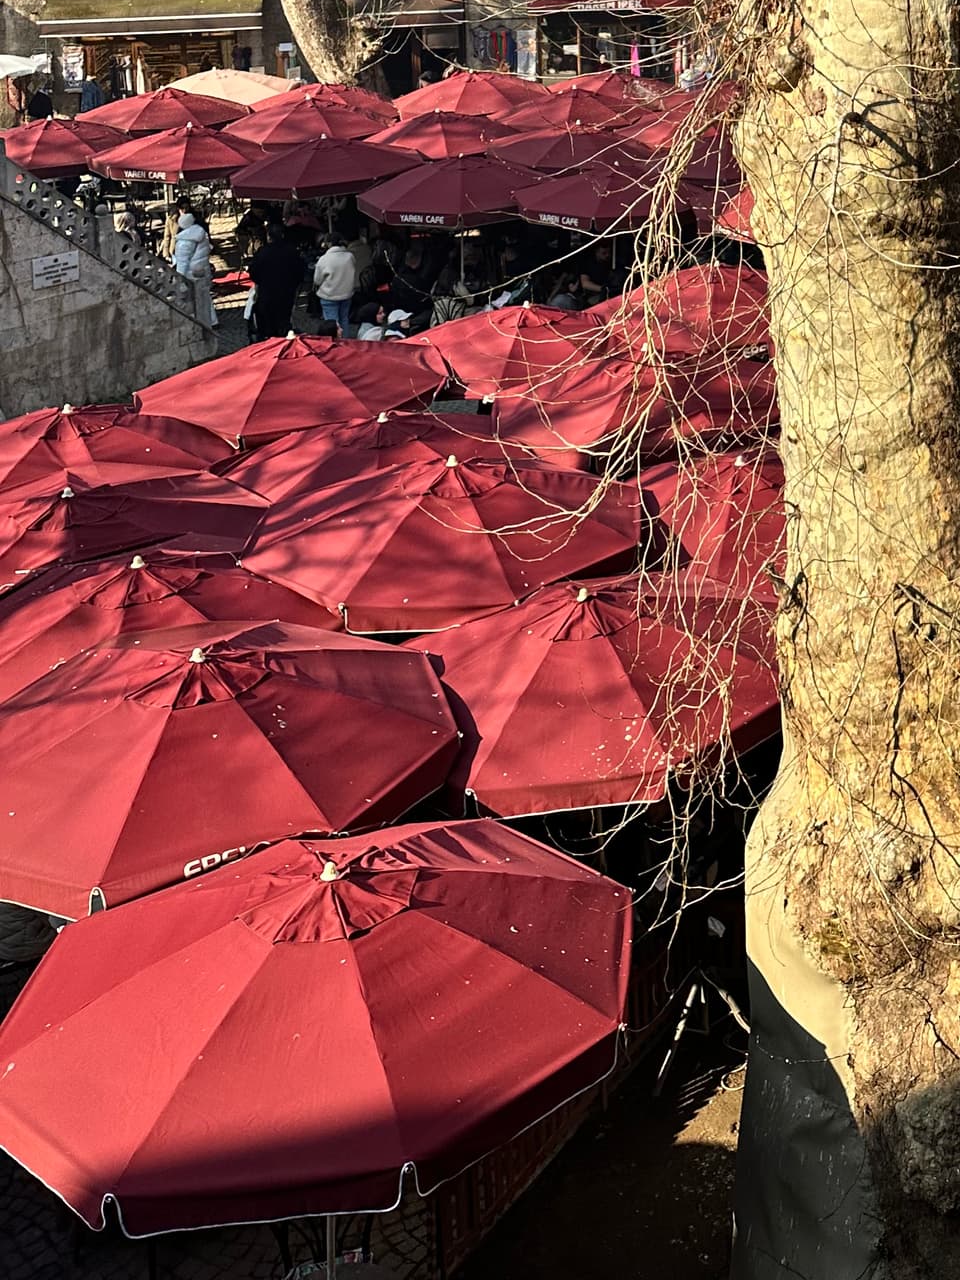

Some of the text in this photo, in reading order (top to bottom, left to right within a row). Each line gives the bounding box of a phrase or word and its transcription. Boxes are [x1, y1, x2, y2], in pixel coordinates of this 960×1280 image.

[124, 170, 166, 180] YAREN CAFE
[400, 214, 444, 224] YAREN CAFE
[561, 216, 578, 227] CAFE
